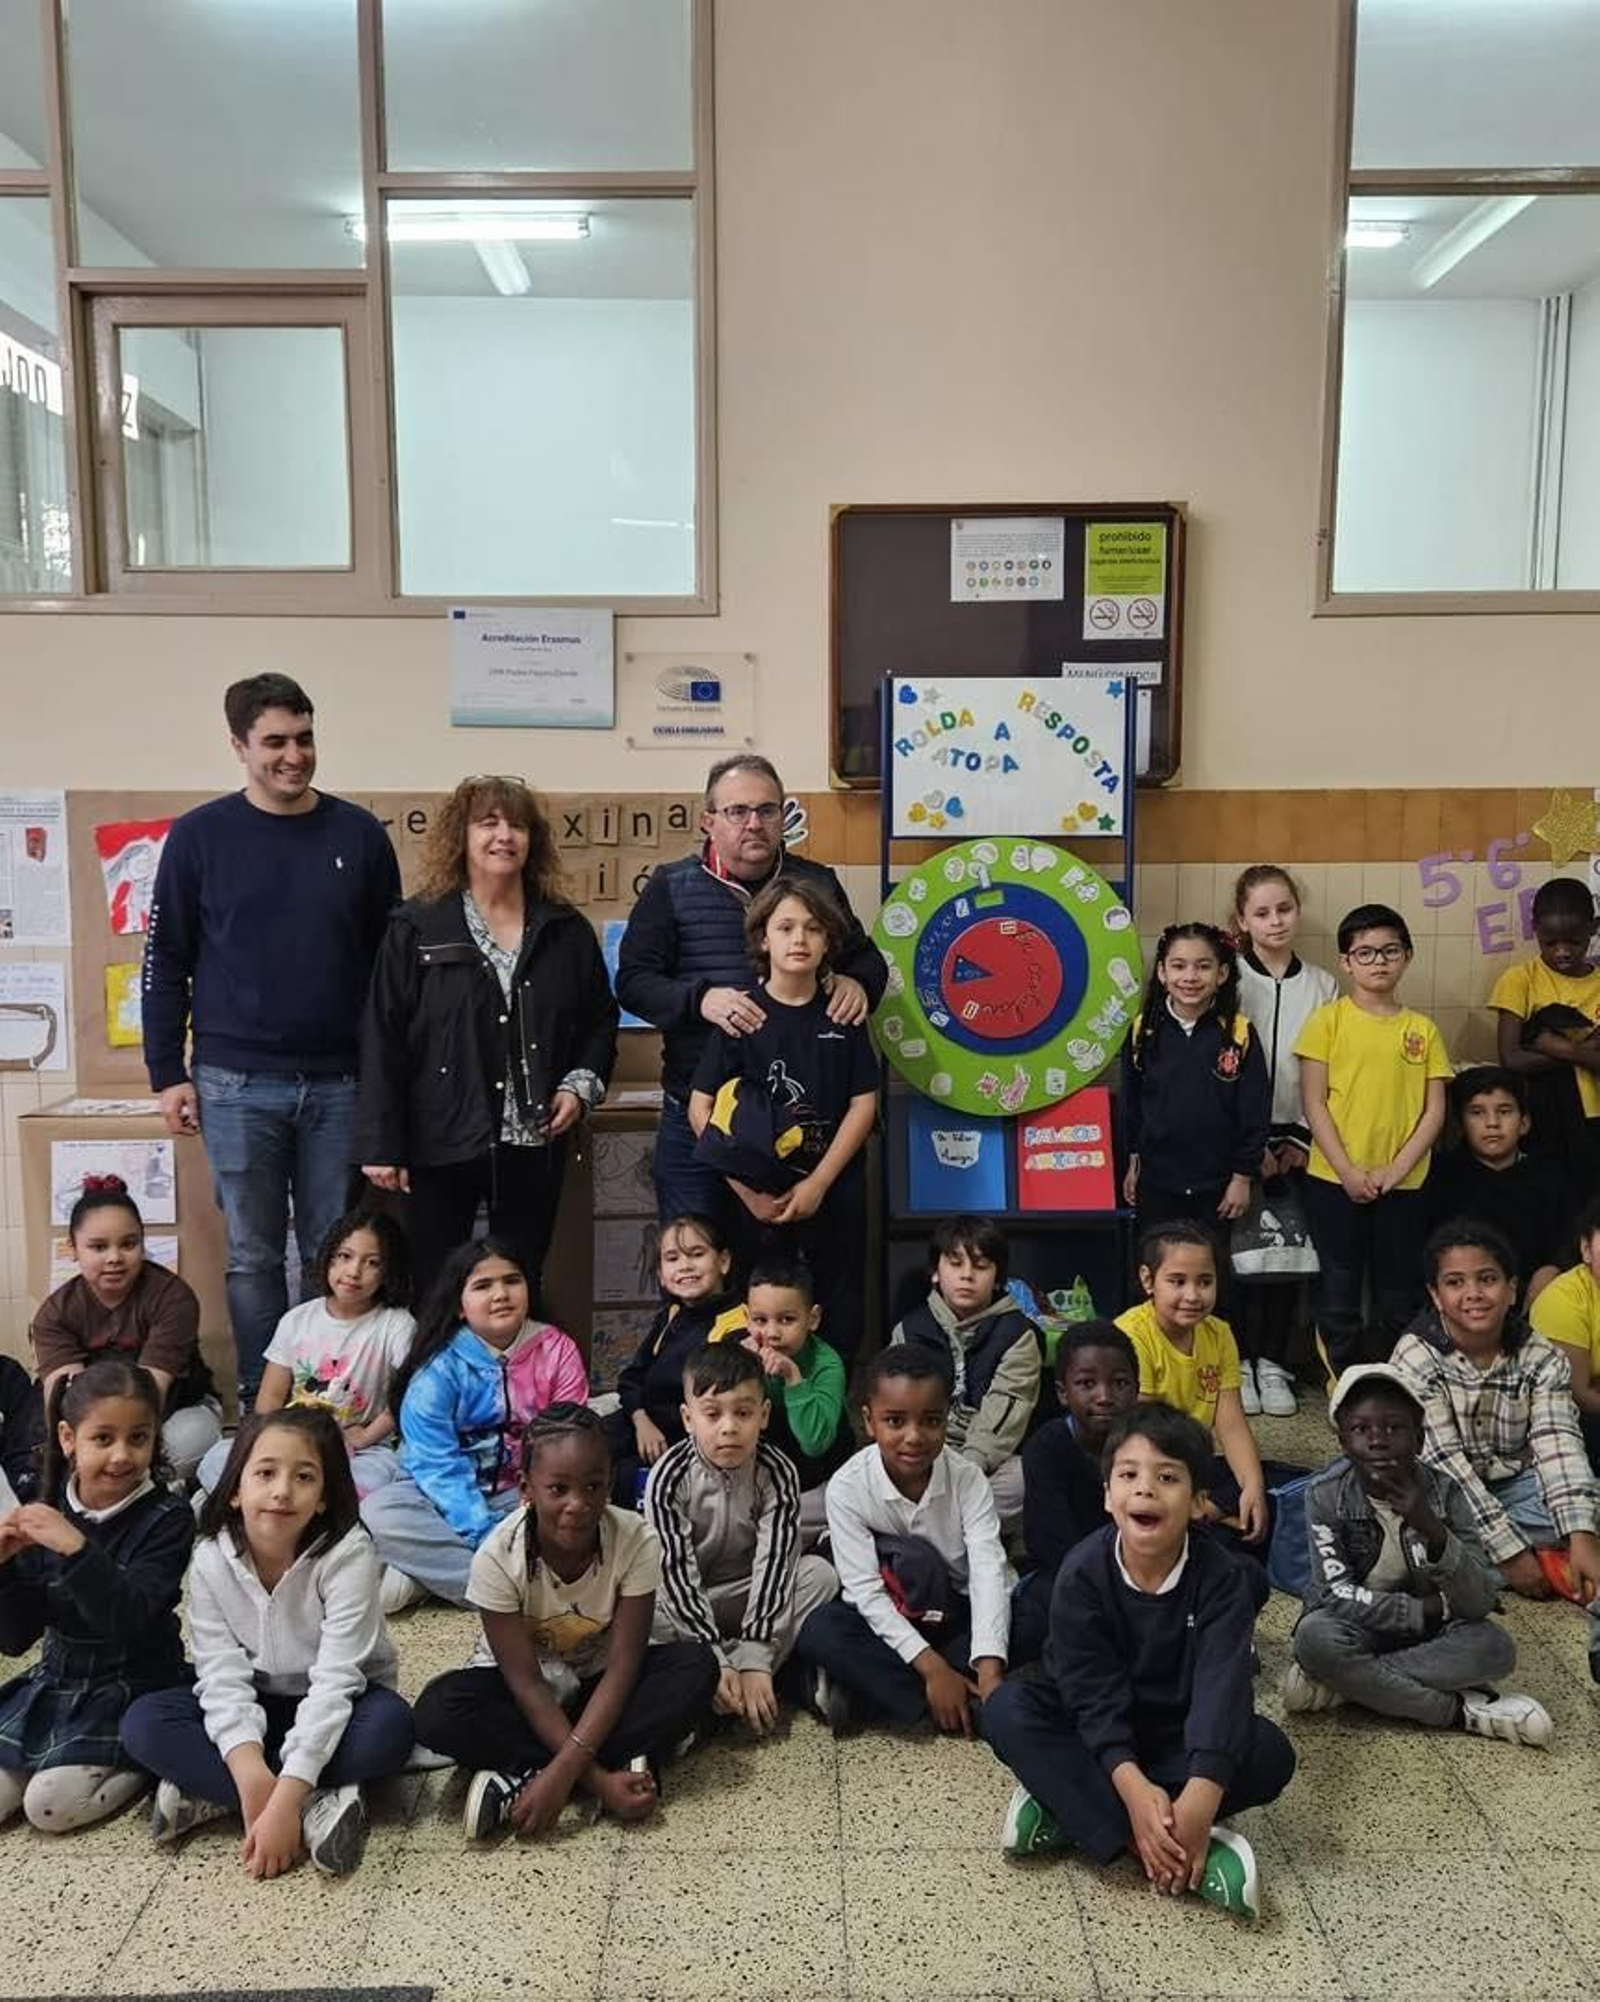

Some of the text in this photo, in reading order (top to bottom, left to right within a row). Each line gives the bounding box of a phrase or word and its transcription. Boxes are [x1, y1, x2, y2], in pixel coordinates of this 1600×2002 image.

[1099, 531, 1152, 543] prohibido
[481, 633, 581, 645] Acreditación Erasmus
[895, 692, 1120, 794] ROLDA A RESPOSTA
[932, 746, 1020, 774] ATOPA
